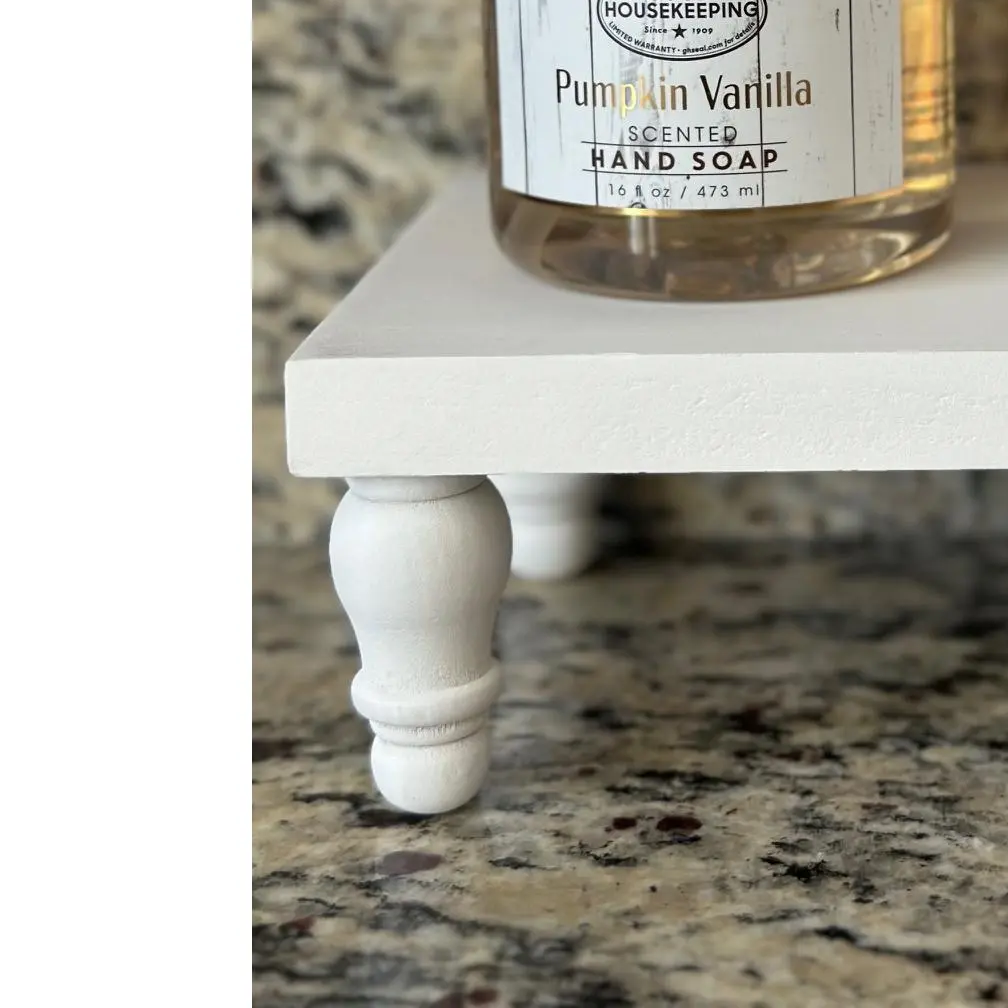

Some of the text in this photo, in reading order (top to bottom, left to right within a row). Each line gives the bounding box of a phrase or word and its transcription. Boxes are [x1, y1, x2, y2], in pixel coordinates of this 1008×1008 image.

[604, 1, 759, 19] HOUSEKEEPING
[608, 21, 757, 55] LIMITED WARRANTY ghseal.com for details
[644, 26, 714, 35] Since 1909
[556, 68, 812, 118] Pumpkin Vanilla
[628, 125, 738, 143] SCENTED
[590, 149, 779, 171] HAND SOAP
[608, 183, 626, 197] 16
[635, 184, 643, 197] fl
[651, 188, 671, 198] oz
[697, 185, 729, 198] 473
[739, 184, 760, 196] ml
